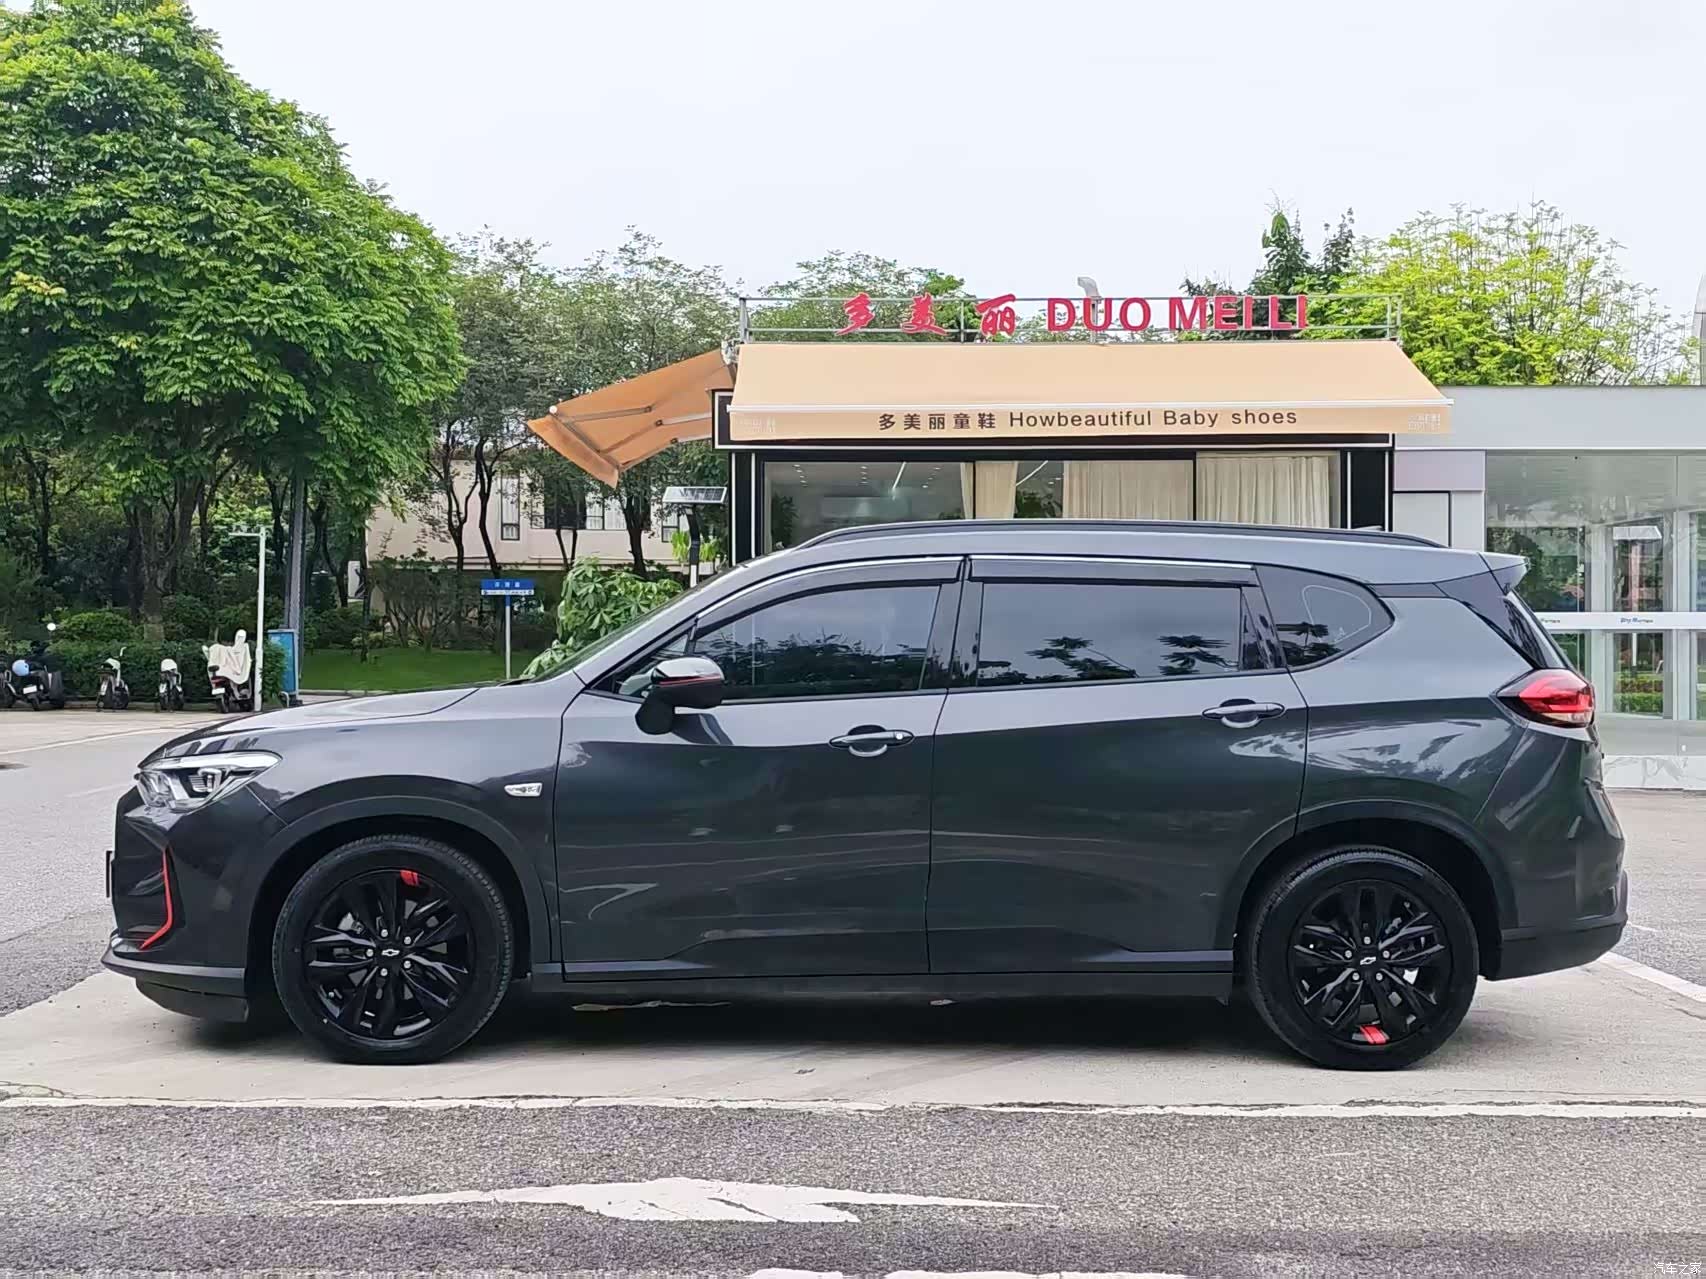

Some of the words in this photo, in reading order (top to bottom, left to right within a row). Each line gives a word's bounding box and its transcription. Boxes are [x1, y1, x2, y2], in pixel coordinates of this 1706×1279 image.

[834, 292, 1016, 337] 多美丽
[1047, 297, 1151, 331] DUO
[878, 412, 996, 431] 多美丽童鞋
[1009, 410, 1151, 427] Howbeautiful
[1163, 409, 1219, 428] Baby
[1231, 409, 1298, 425] shoes
